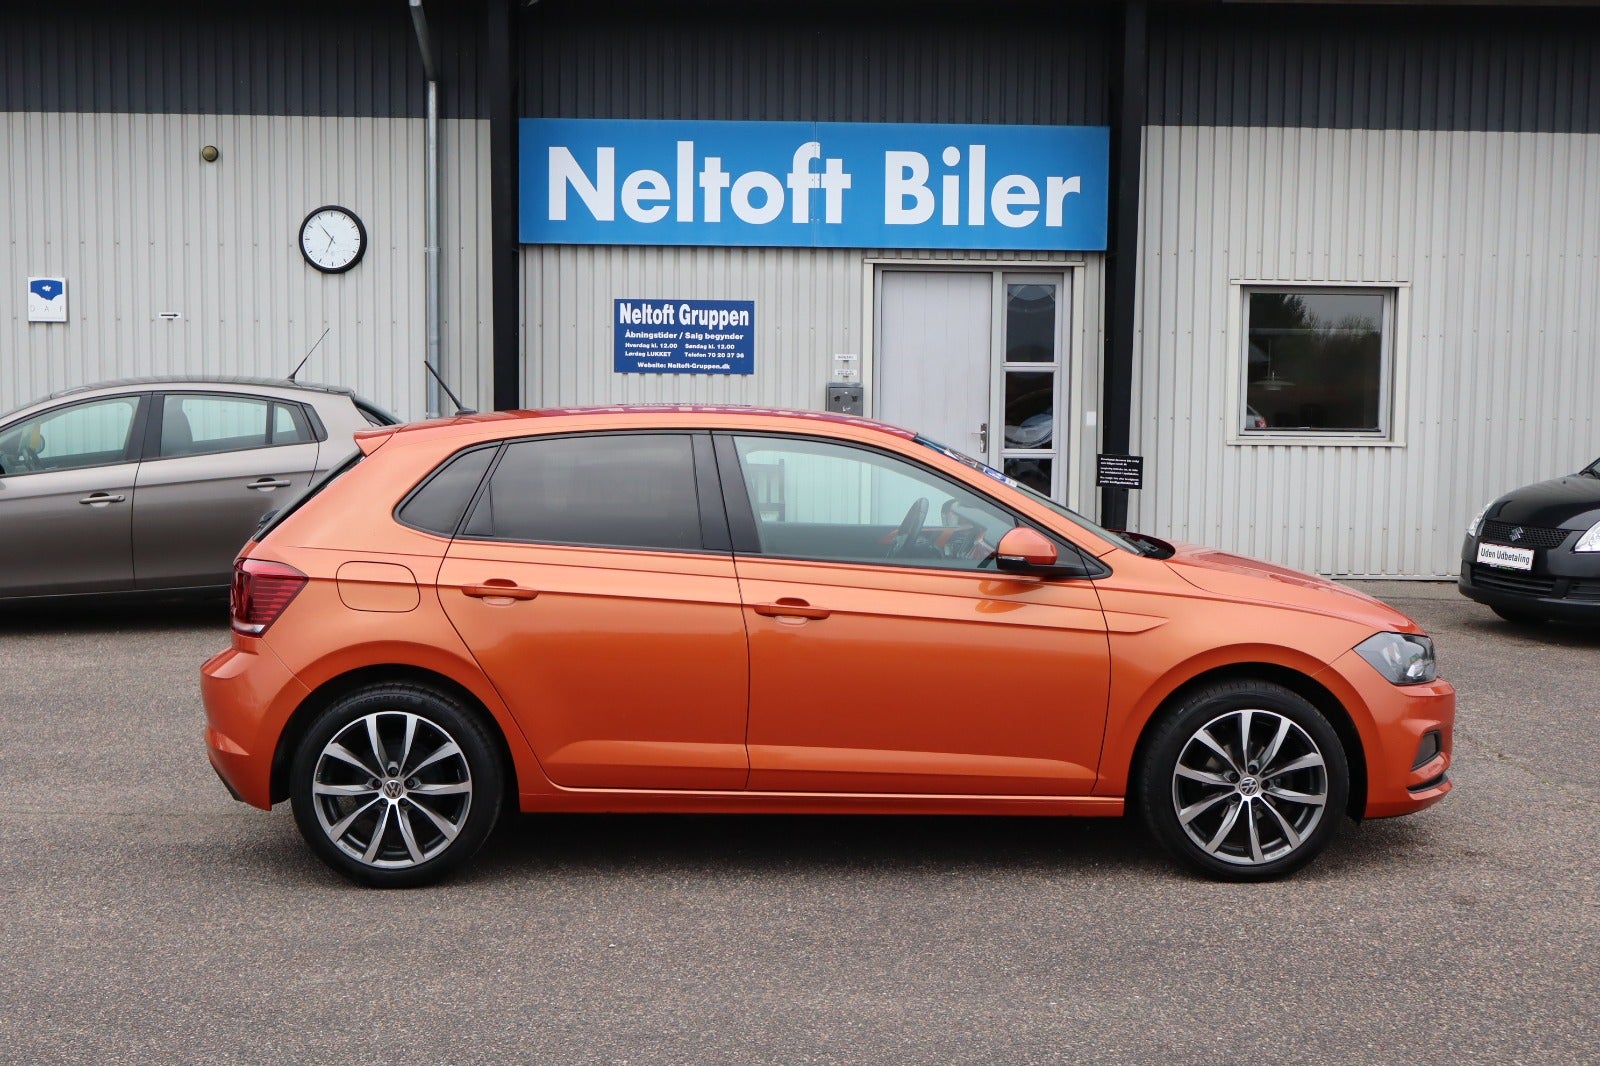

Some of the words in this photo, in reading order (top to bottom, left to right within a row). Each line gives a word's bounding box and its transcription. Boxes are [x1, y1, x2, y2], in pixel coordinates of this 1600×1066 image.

[548, 140, 852, 225] Neltoft
[884, 144, 1081, 228] Biler
[619, 303, 674, 324] Neltoft
[679, 304, 749, 330] Gruppen
[624, 329, 678, 340] Åbningstider
[685, 332, 703, 341] Salg
[705, 332, 744, 341] begynder
[637, 361, 667, 369] Website:
[1481, 548, 1495, 558] Uden
[1496, 551, 1530, 565] Udbetaling
